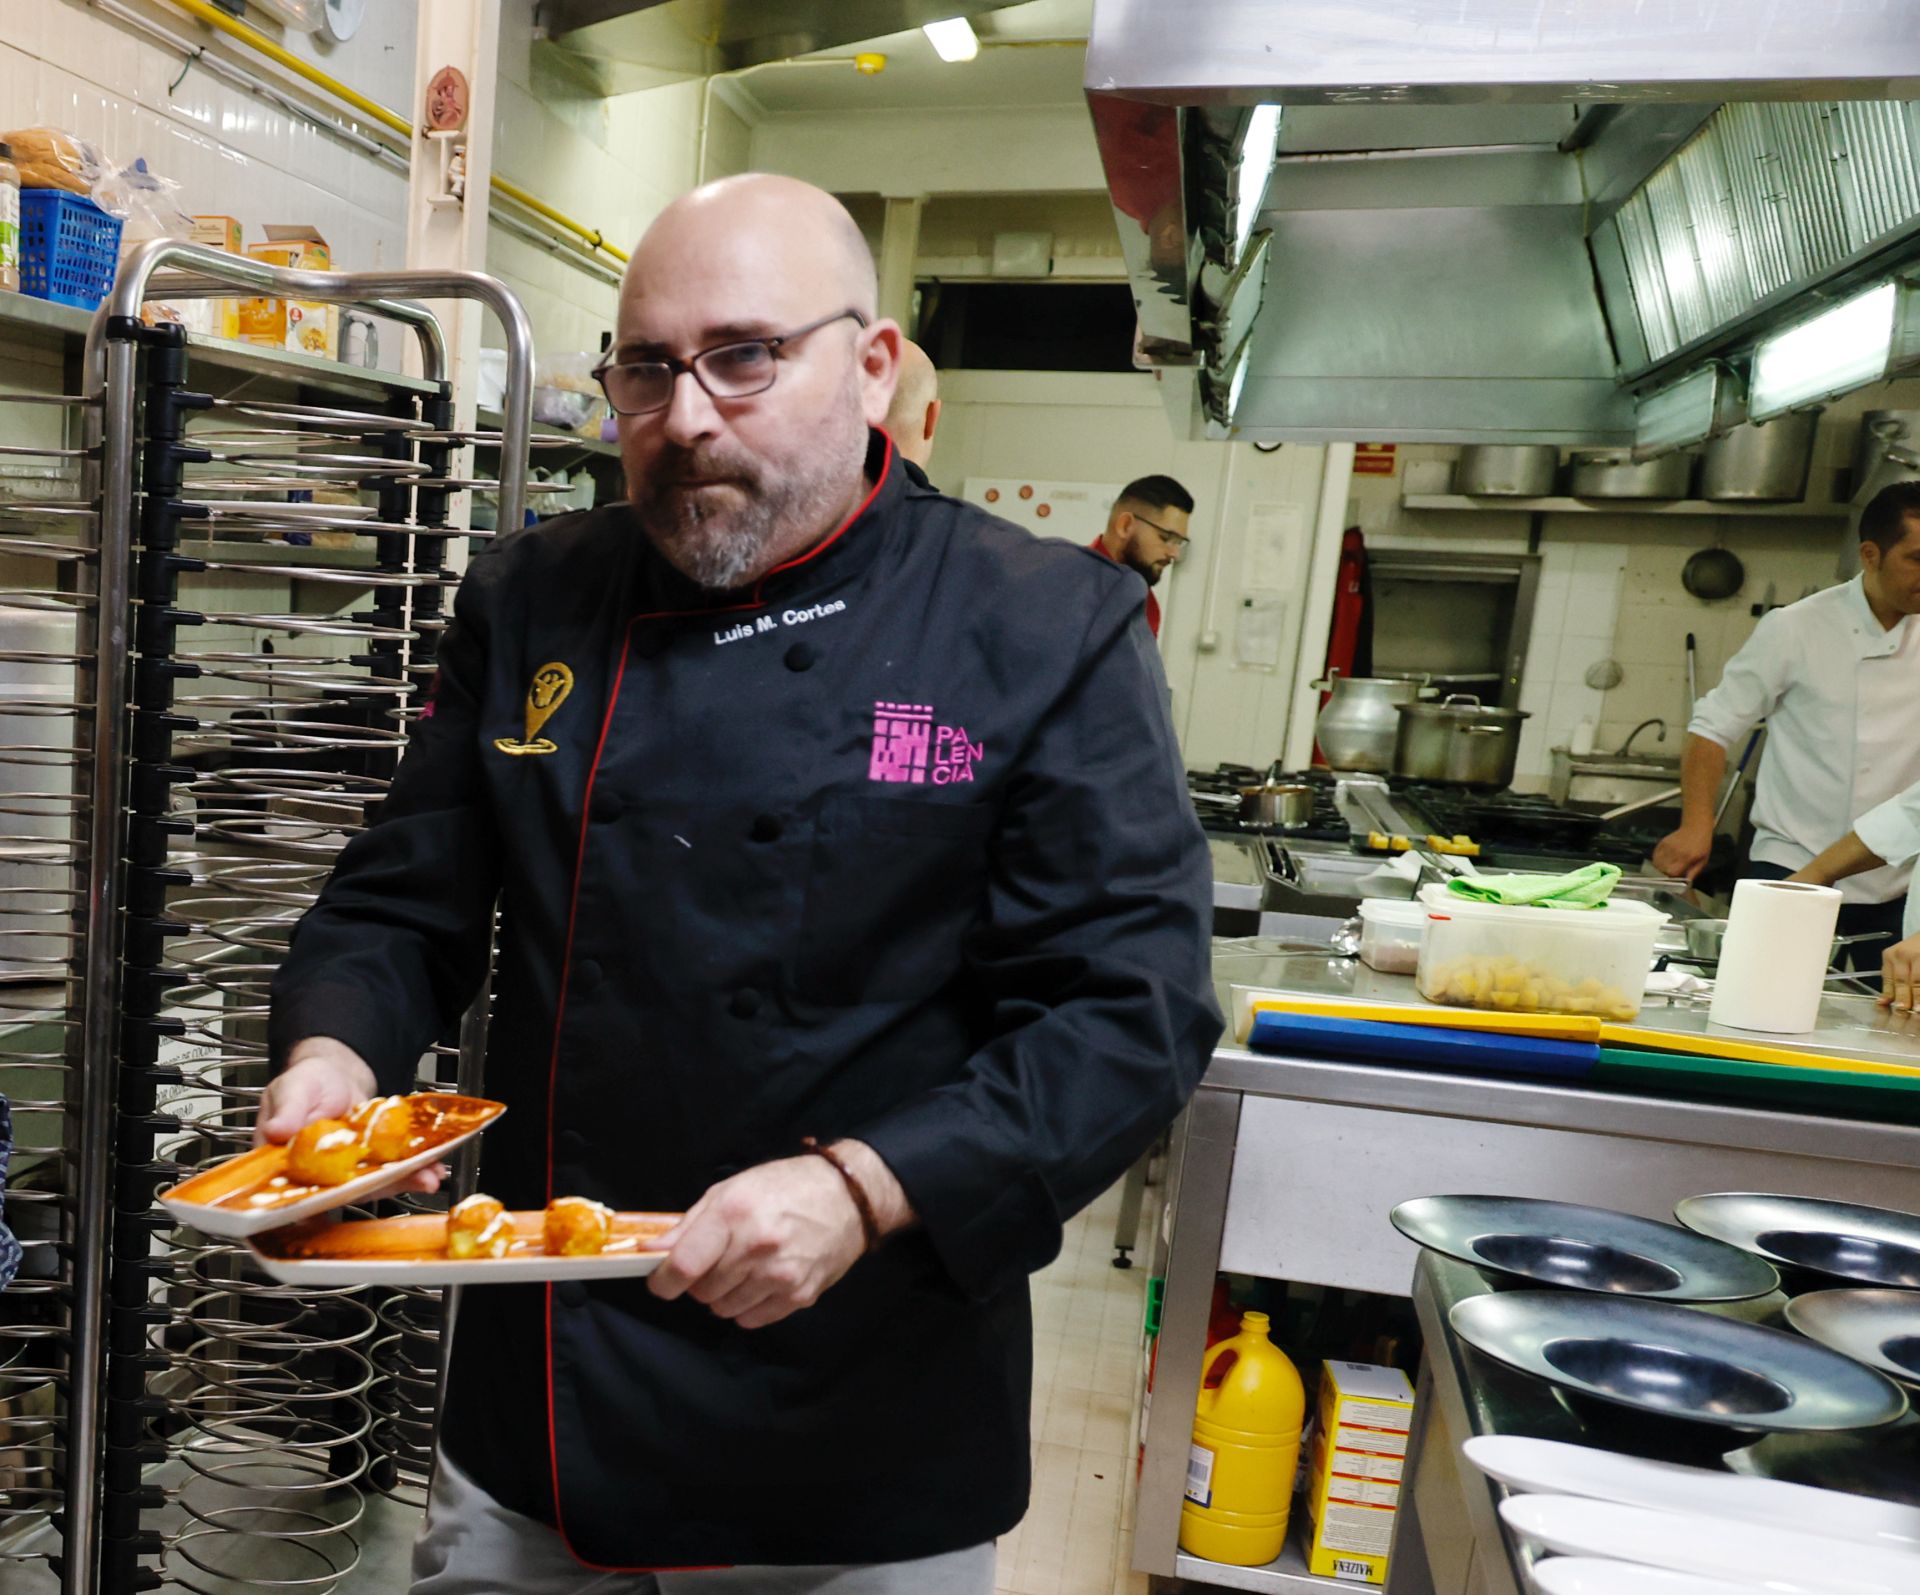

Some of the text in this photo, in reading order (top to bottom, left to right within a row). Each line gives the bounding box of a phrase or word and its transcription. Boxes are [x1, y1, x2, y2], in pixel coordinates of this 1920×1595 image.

[713, 599, 846, 645] Luis M. Cortes
[936, 725, 969, 745] PA
[934, 741, 983, 765] LEN
[931, 763, 974, 785] CIA
[1332, 1559, 1374, 1576] MAIZENA
